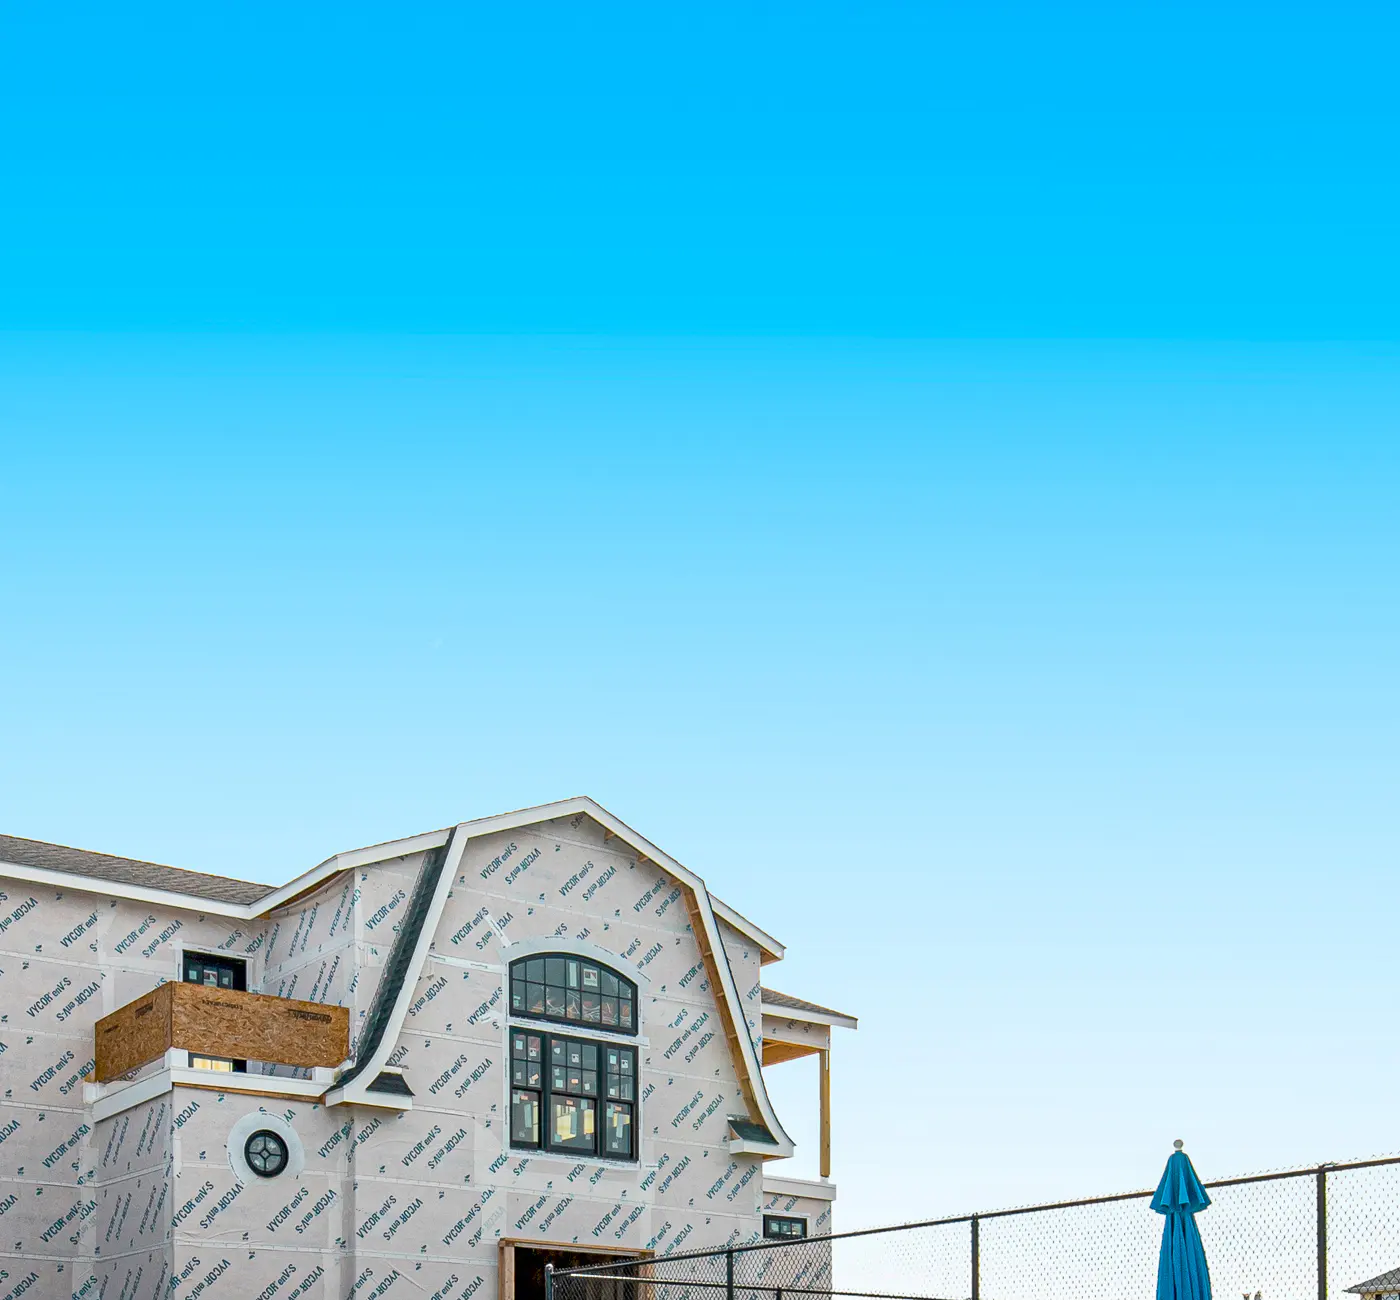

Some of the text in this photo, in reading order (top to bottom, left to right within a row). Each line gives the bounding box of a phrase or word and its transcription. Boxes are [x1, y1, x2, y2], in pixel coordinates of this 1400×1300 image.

[480, 857, 501, 879] VYCOR
[521, 848, 541, 871] VYCOR
[559, 873, 579, 896] VYCOR
[598, 866, 617, 888] VYCOR
[11, 897, 38, 920] VYCOR
[365, 906, 388, 930] VYCOR
[0, 918, 12, 935] enV
[60, 924, 86, 947] VYCOR
[161, 920, 183, 943] VYCOR
[451, 922, 473, 945] VYCOR
[115, 930, 139, 954] VYCOR
[75, 982, 100, 1007] VYCOR
[427, 977, 448, 1001] VYCOR
[26, 992, 53, 1017] VYCOR
[30, 1066, 57, 1092] VYCOR
[429, 1070, 452, 1095] VYCOR
[471, 1059, 492, 1082] VYCOR
[174, 1102, 200, 1128] VYCOR
[671, 1104, 690, 1128] VYCOR
[707, 1094, 724, 1116] VYCOR
[357, 1118, 382, 1144] VYCOR
[445, 1128, 467, 1153] VYCOR
[42, 1143, 68, 1168] VYCOR
[401, 1141, 425, 1167] VYCOR
[672, 1156, 691, 1179] VYCOR
[740, 1165, 758, 1186] VYCOR
[219, 1183, 244, 1211] VYCOR
[706, 1176, 725, 1199] VYCOR
[171, 1202, 196, 1228] VYCOR
[312, 1189, 337, 1216] VYCOR
[400, 1198, 423, 1224] VYCOR
[40, 1218, 67, 1243] VYCOR
[266, 1205, 292, 1232] VYCOR
[356, 1212, 381, 1238] VYCOR
[442, 1220, 466, 1246] VYCOR
[12, 1272, 39, 1298] VYCOR
[204, 1259, 231, 1286] VYCOR
[300, 1266, 325, 1293] VYCOR
[376, 1270, 400, 1296] VYCOR
